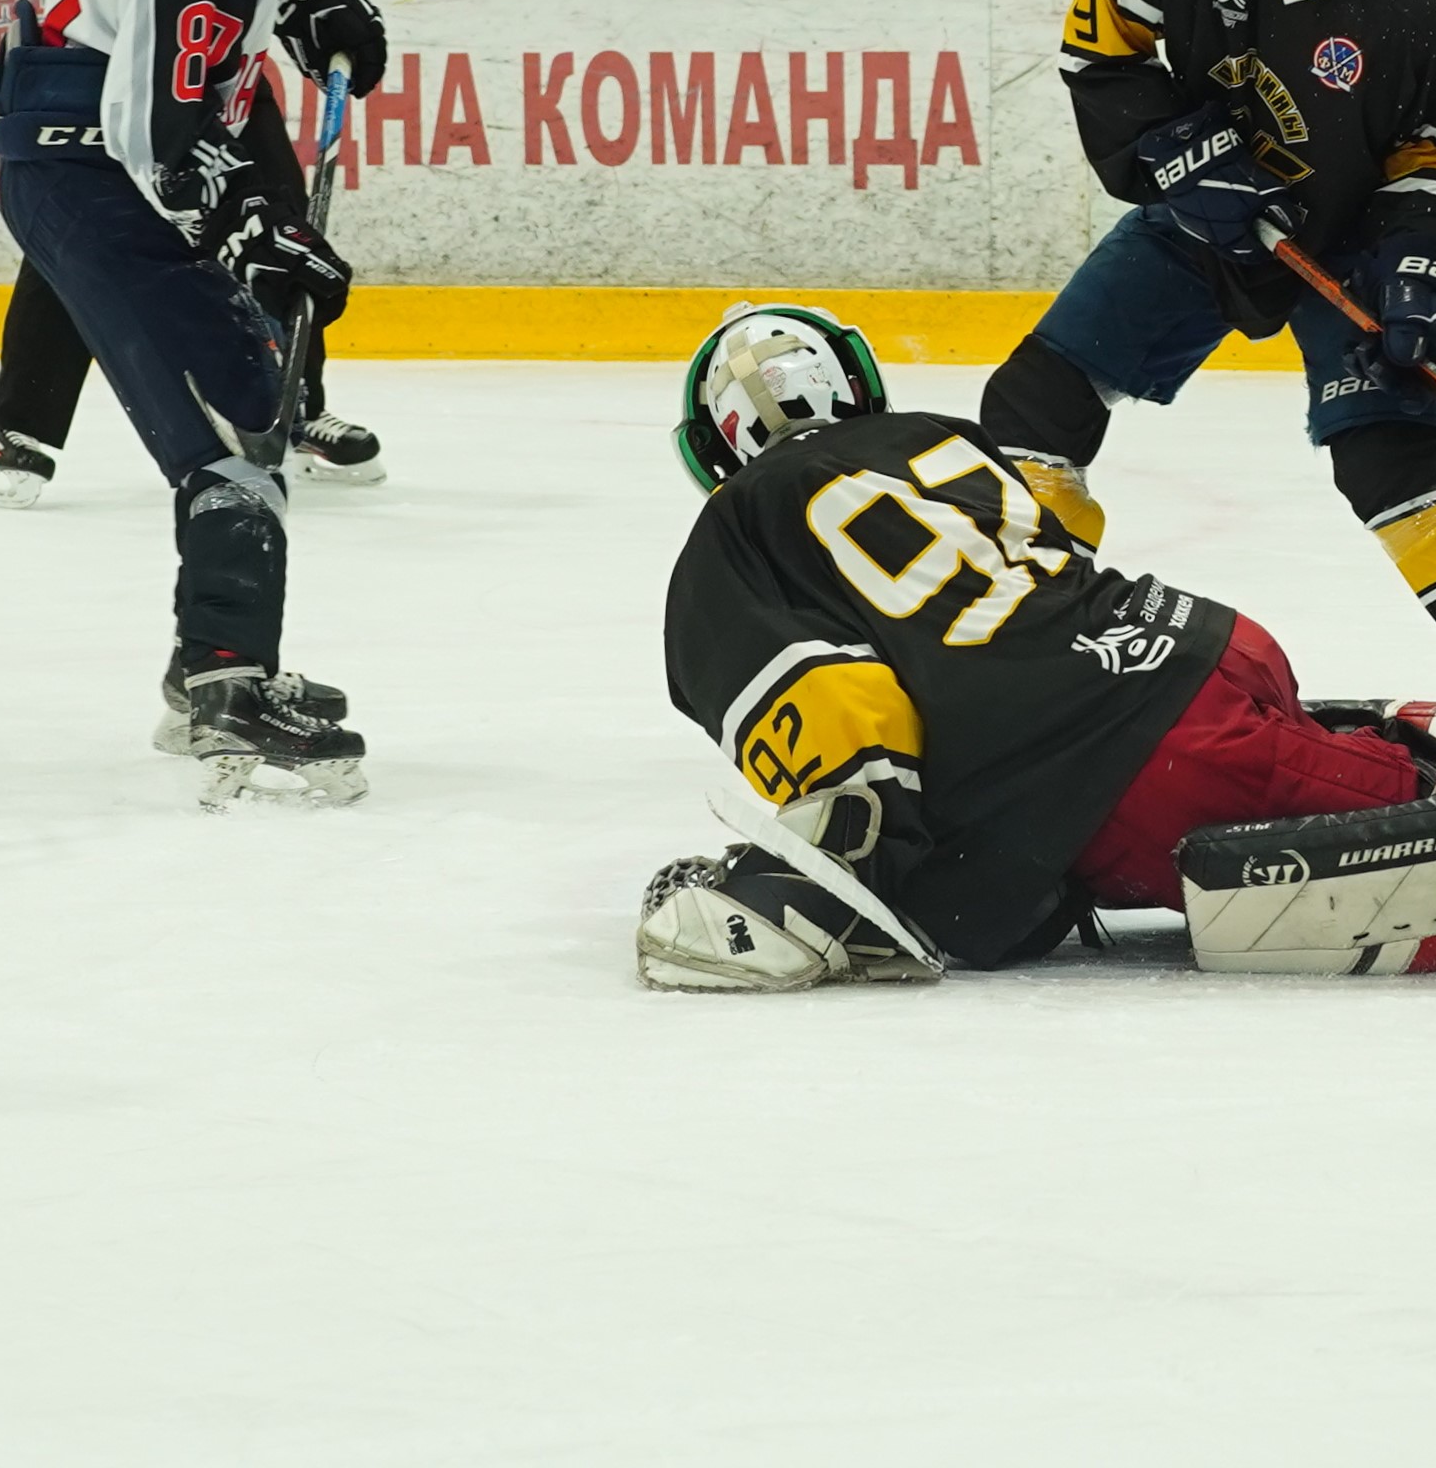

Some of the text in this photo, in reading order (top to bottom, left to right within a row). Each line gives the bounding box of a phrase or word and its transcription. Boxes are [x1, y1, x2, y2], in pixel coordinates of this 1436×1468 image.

[172, 0, 244, 103] 87
[523, 49, 981, 190] КОМАНДА
[806, 434, 1071, 647] 92
[747, 701, 822, 799] 92
